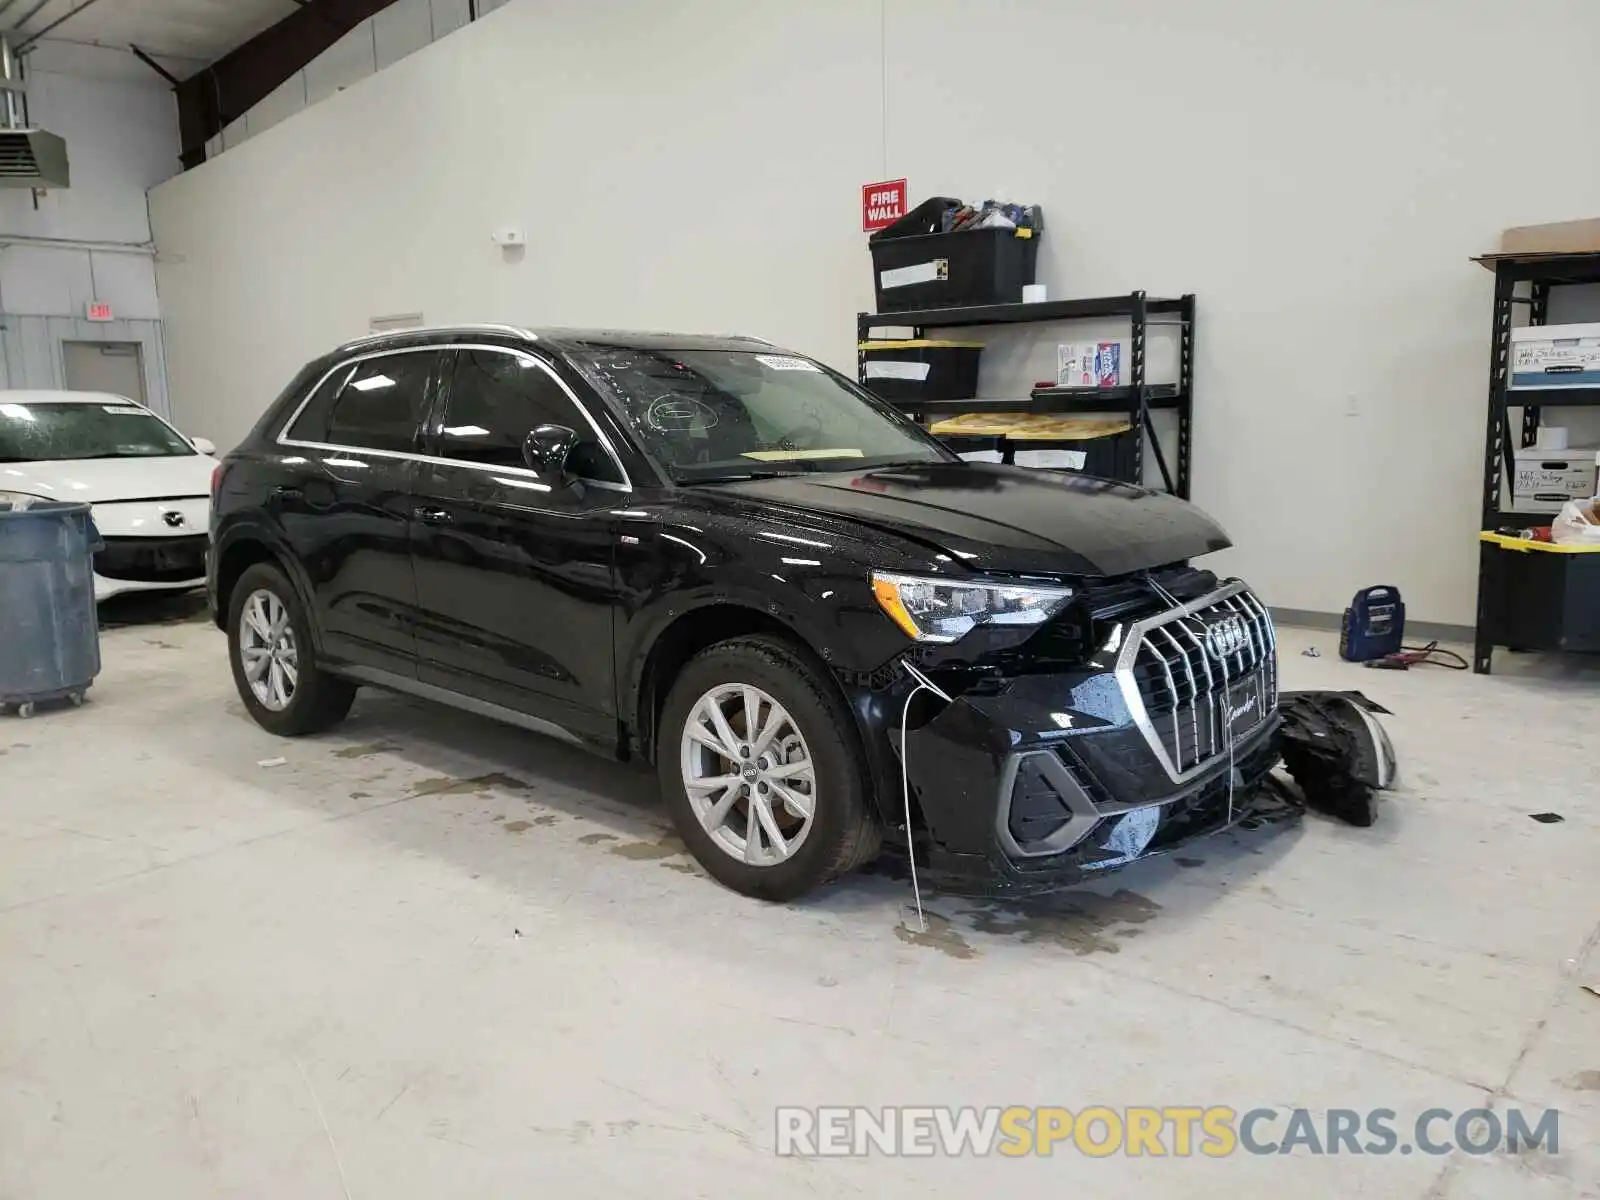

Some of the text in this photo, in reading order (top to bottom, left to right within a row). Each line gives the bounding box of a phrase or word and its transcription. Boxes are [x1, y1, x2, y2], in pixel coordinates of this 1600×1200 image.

[870, 190, 899, 207] FIRE
[867, 205, 903, 222] WALL
[90, 303, 110, 318] EXIT
